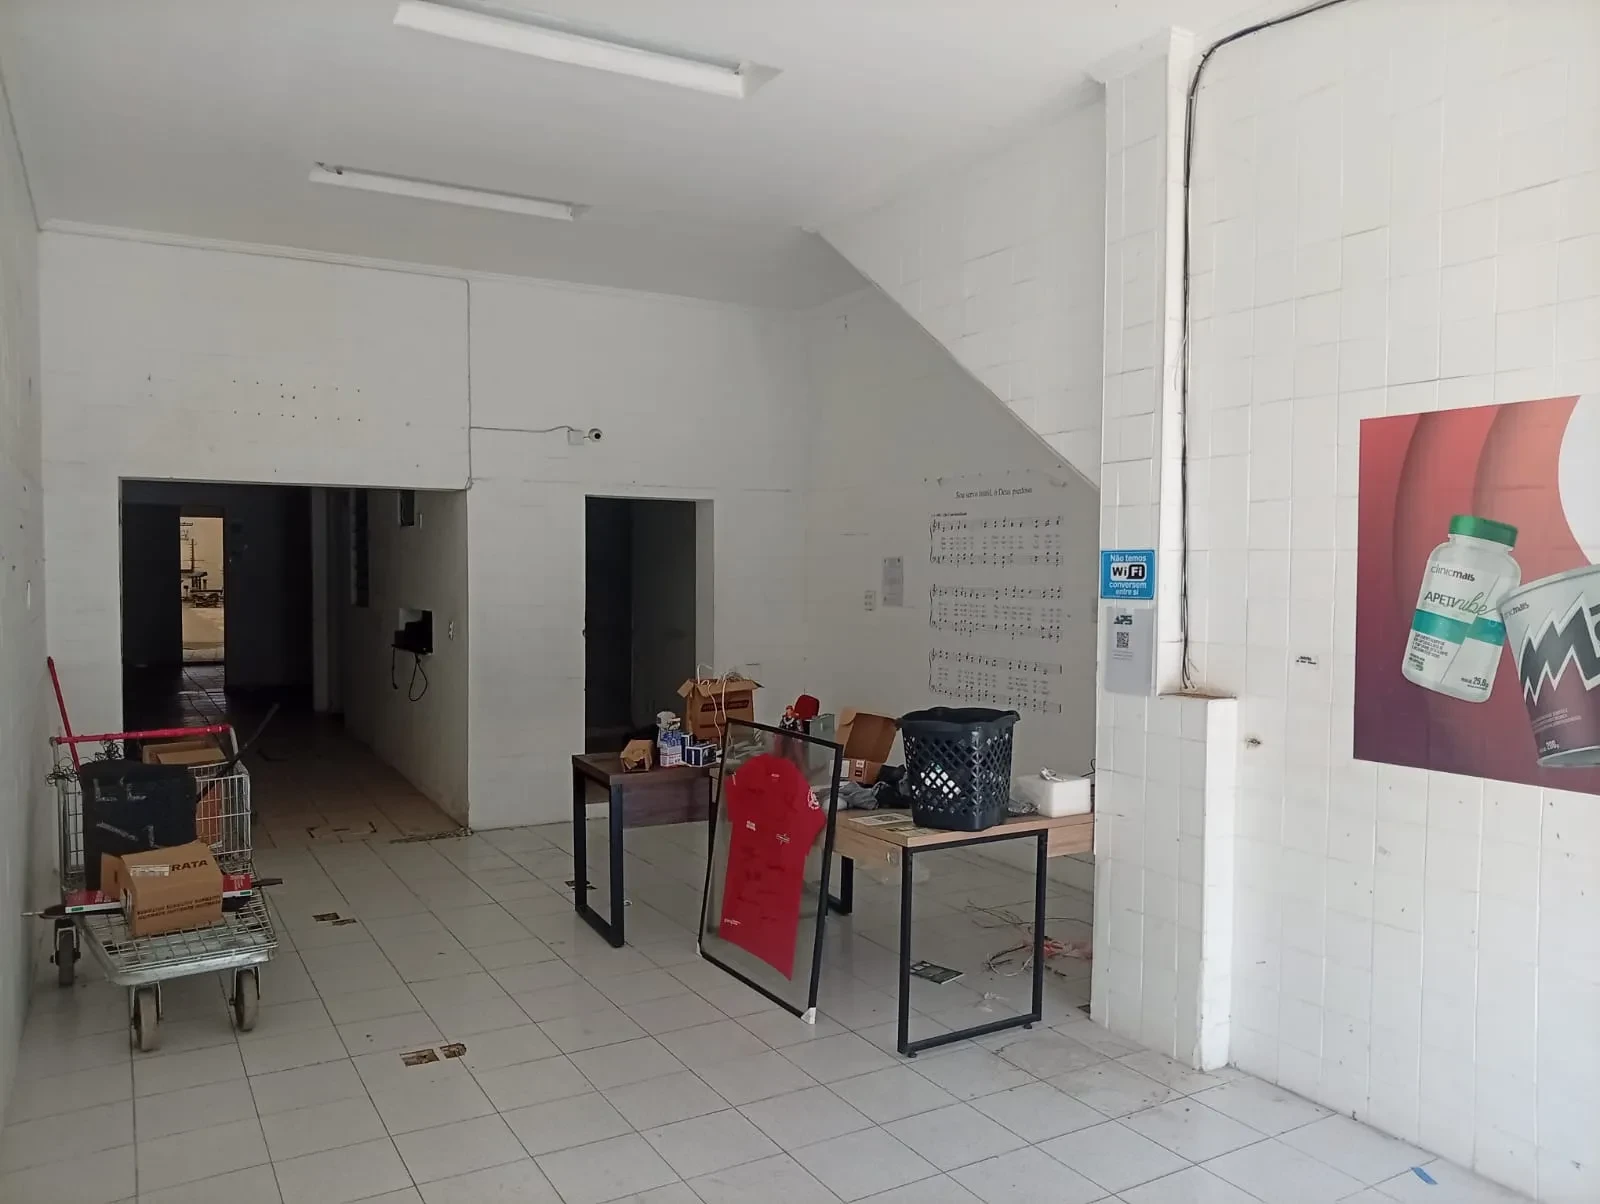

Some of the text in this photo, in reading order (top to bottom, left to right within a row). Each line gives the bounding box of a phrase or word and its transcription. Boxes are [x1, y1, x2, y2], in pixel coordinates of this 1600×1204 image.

[1110, 554, 1147, 562] Não temos
[1430, 564, 1475, 582] clinicmais
[170, 860, 209, 872] RATA
